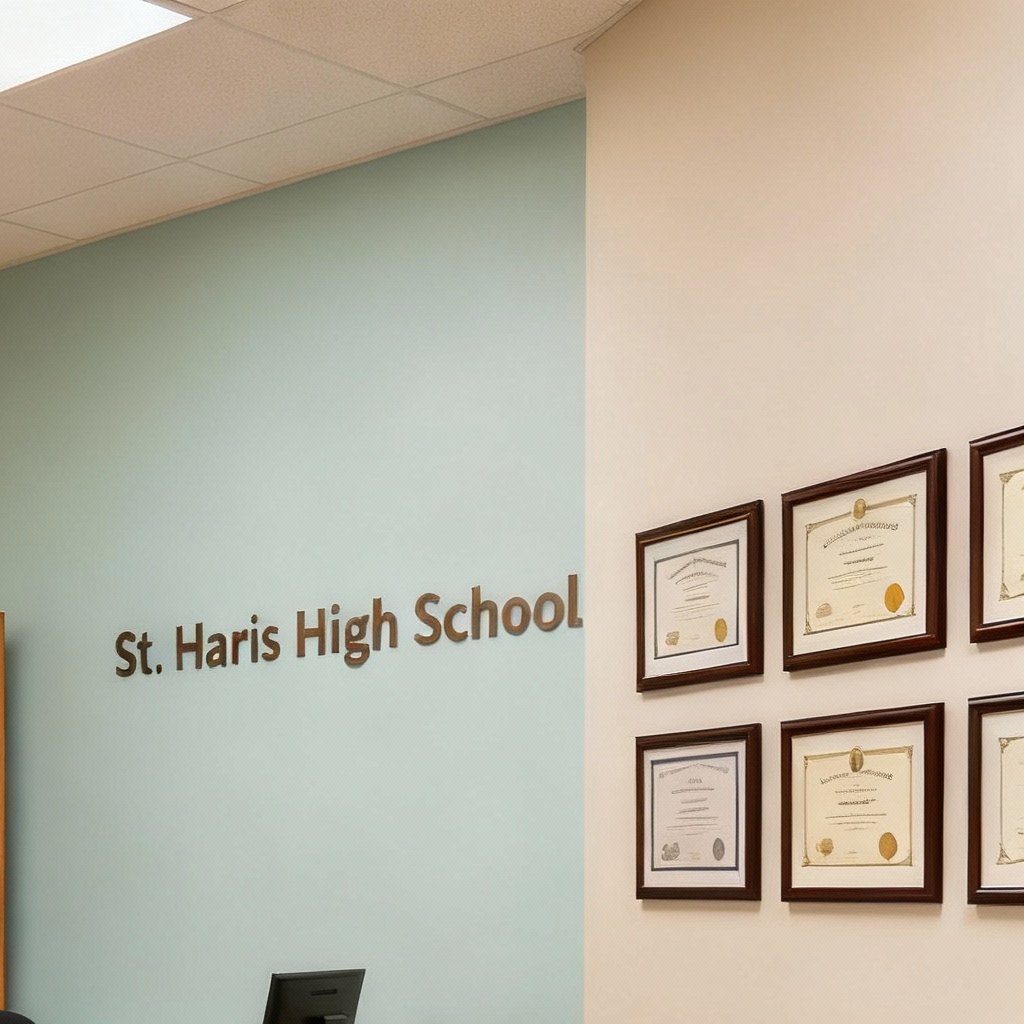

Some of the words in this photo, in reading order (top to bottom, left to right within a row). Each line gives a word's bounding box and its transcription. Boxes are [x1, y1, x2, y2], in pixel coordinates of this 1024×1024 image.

[115, 631, 163, 678] St.
[175, 614, 282, 671] Haris
[296, 597, 399, 668] High
[413, 573, 583, 646] School
